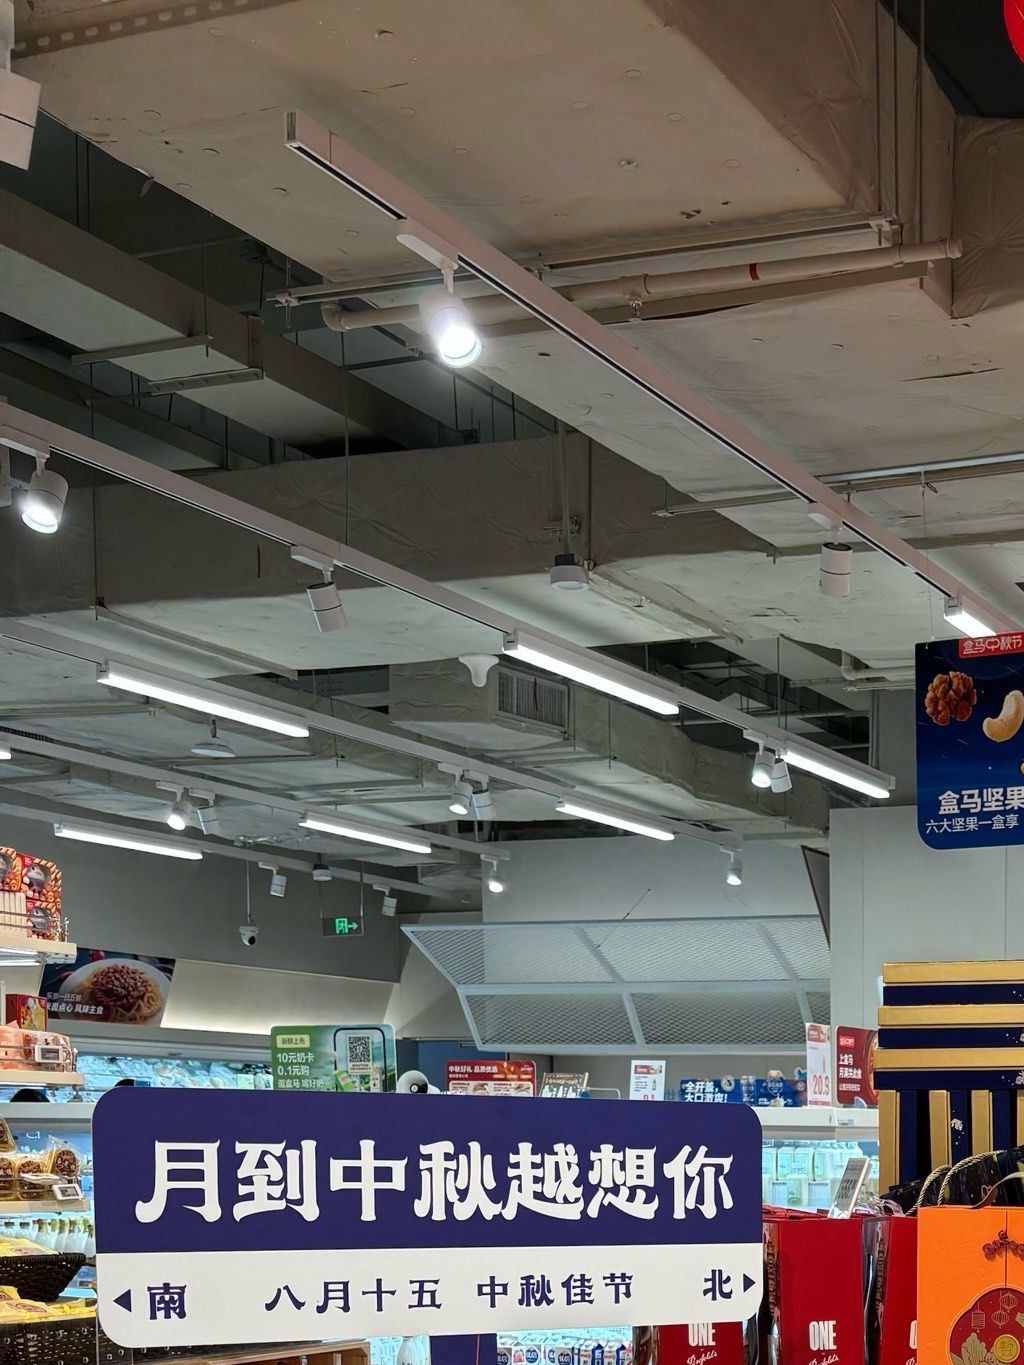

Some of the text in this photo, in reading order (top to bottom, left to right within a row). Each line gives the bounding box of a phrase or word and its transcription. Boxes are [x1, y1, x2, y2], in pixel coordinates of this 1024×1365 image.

[963, 635, 1022, 655] 盒马中秋节
[925, 813, 1019, 834] 六大坚果一盒享
[276, 1053, 314, 1062] 10元奶卡
[135, 1139, 734, 1223] 月到中秋越想你
[147, 1269, 733, 1320] 南 八月十五 中秋佳节 北
[688, 1323, 716, 1347] ONE
[809, 1321, 837, 1351] ONE
